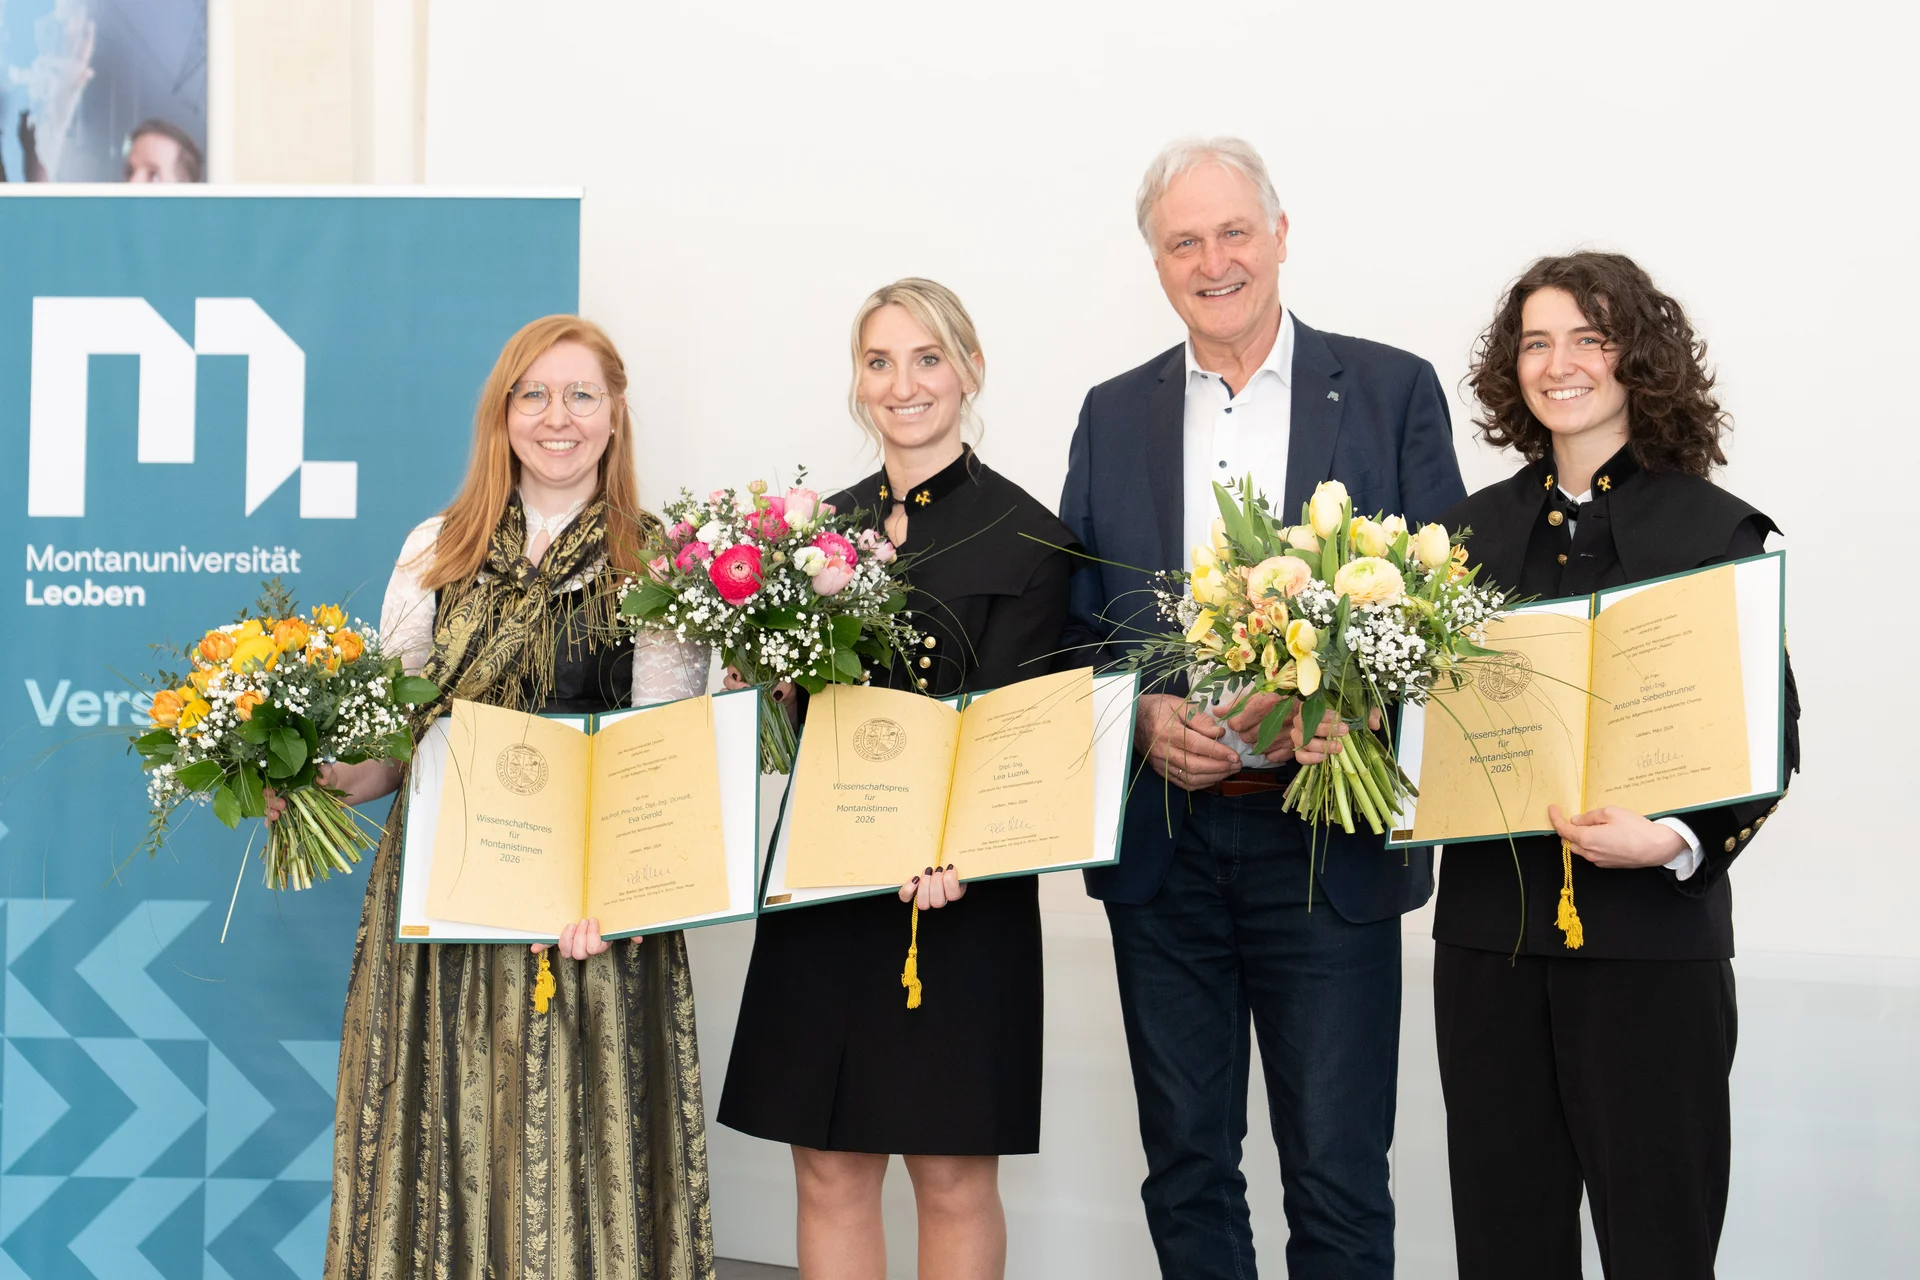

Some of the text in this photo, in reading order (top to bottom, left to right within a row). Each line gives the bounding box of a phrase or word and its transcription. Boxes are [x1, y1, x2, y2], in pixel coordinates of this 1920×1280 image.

[26, 544, 301, 574] Montanuniversität
[25, 579, 146, 607] Leoben
[1613, 683, 1696, 711] Antonia Siebenbrunner
[1463, 723, 1543, 741] Wissenschaftspreis
[1498, 739, 1510, 748] für
[1469, 748, 1534, 764] Montanistinnen
[1008, 769, 1030, 777] Luznik
[1490, 763, 1512, 774] 2026
[833, 783, 910, 793] Wissenschaftspreis
[836, 804, 898, 813] Montanistinnen
[628, 810, 662, 823] Eva Gerold
[855, 815, 876, 823] 2026
[476, 814, 553, 834] Wissenschaftspreis
[508, 831, 520, 840] für
[480, 838, 543, 855] Montanistinnen
[500, 853, 521, 864] 2026
